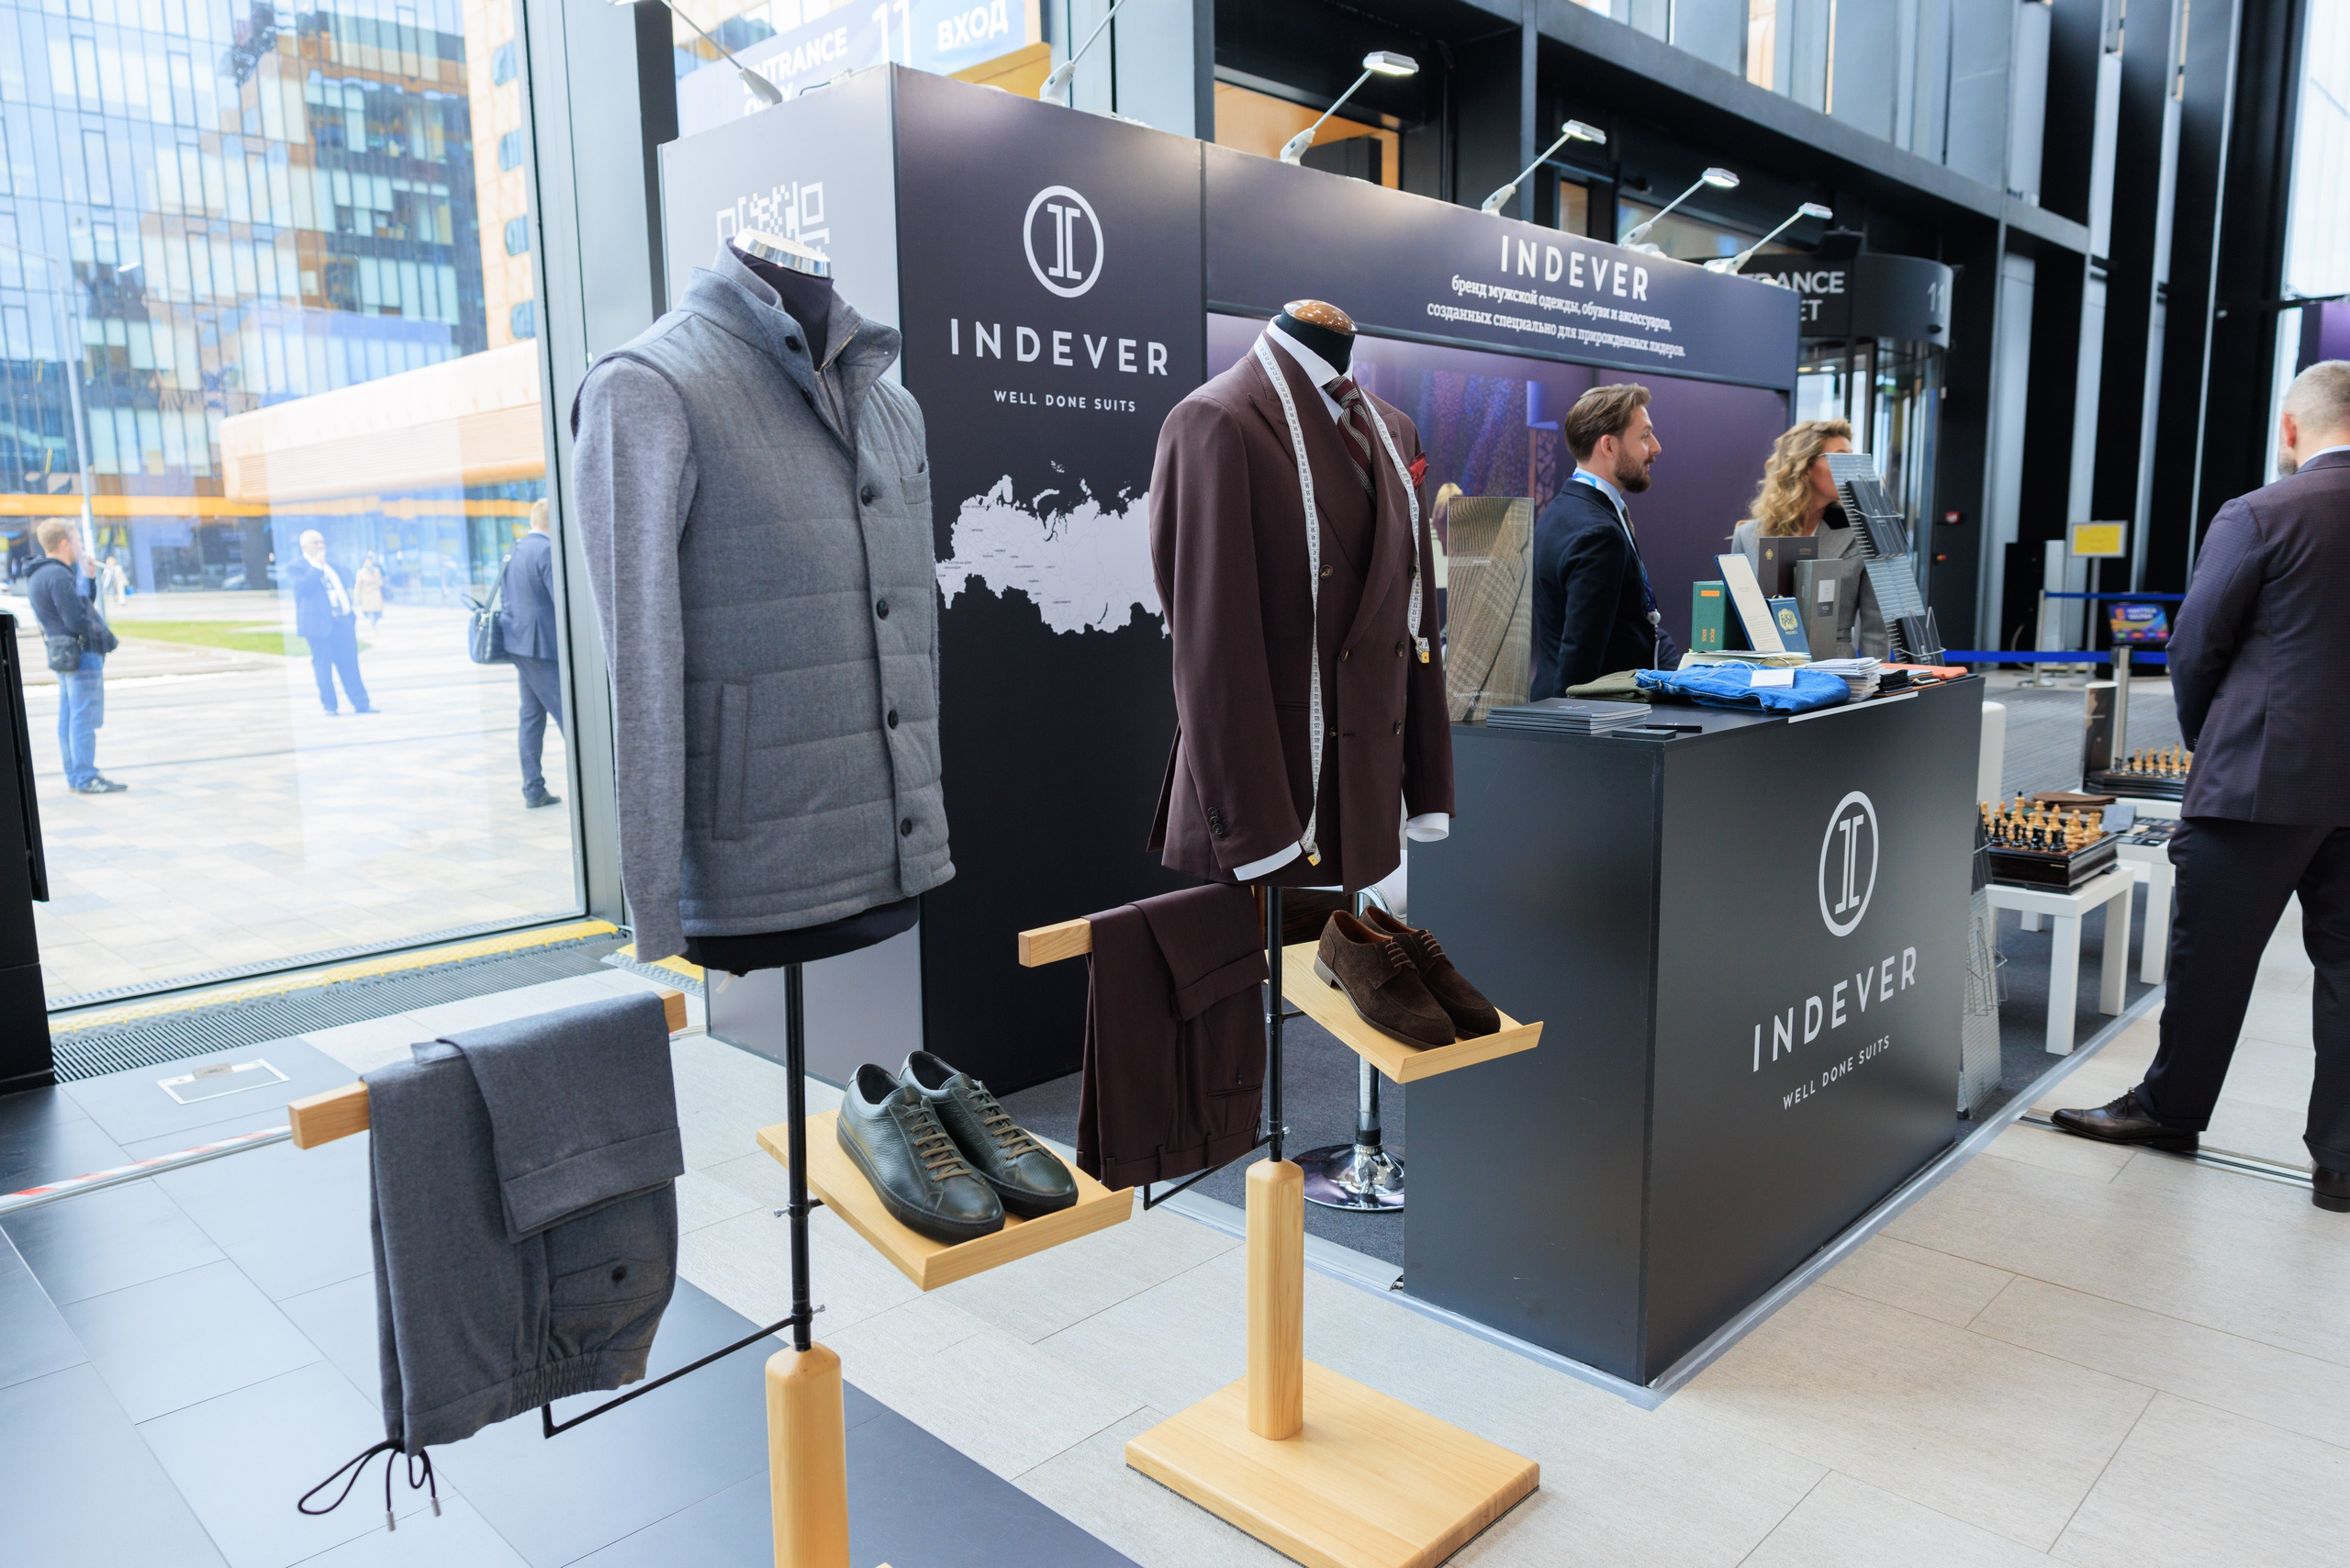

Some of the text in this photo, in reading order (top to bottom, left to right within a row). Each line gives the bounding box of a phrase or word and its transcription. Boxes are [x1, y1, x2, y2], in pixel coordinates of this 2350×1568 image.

[937, 0, 1009, 51] ВХОД
[1501, 235, 1649, 302] INDEVER
[1451, 274, 1487, 298] бренд
[1488, 285, 1538, 306] мужской
[1539, 295, 1581, 315] одежды,
[1582, 301, 1610, 320] обуви
[1611, 308, 1618, 320] и
[951, 319, 1168, 375] INDEVER
[1427, 303, 1685, 359] созданных специально для прирожденных лидеров.
[994, 390, 1136, 412] WELL DONE SUITS
[1752, 946, 1917, 1073] INDEVER
[1783, 1035, 1890, 1111] WELL DONE SUITS
